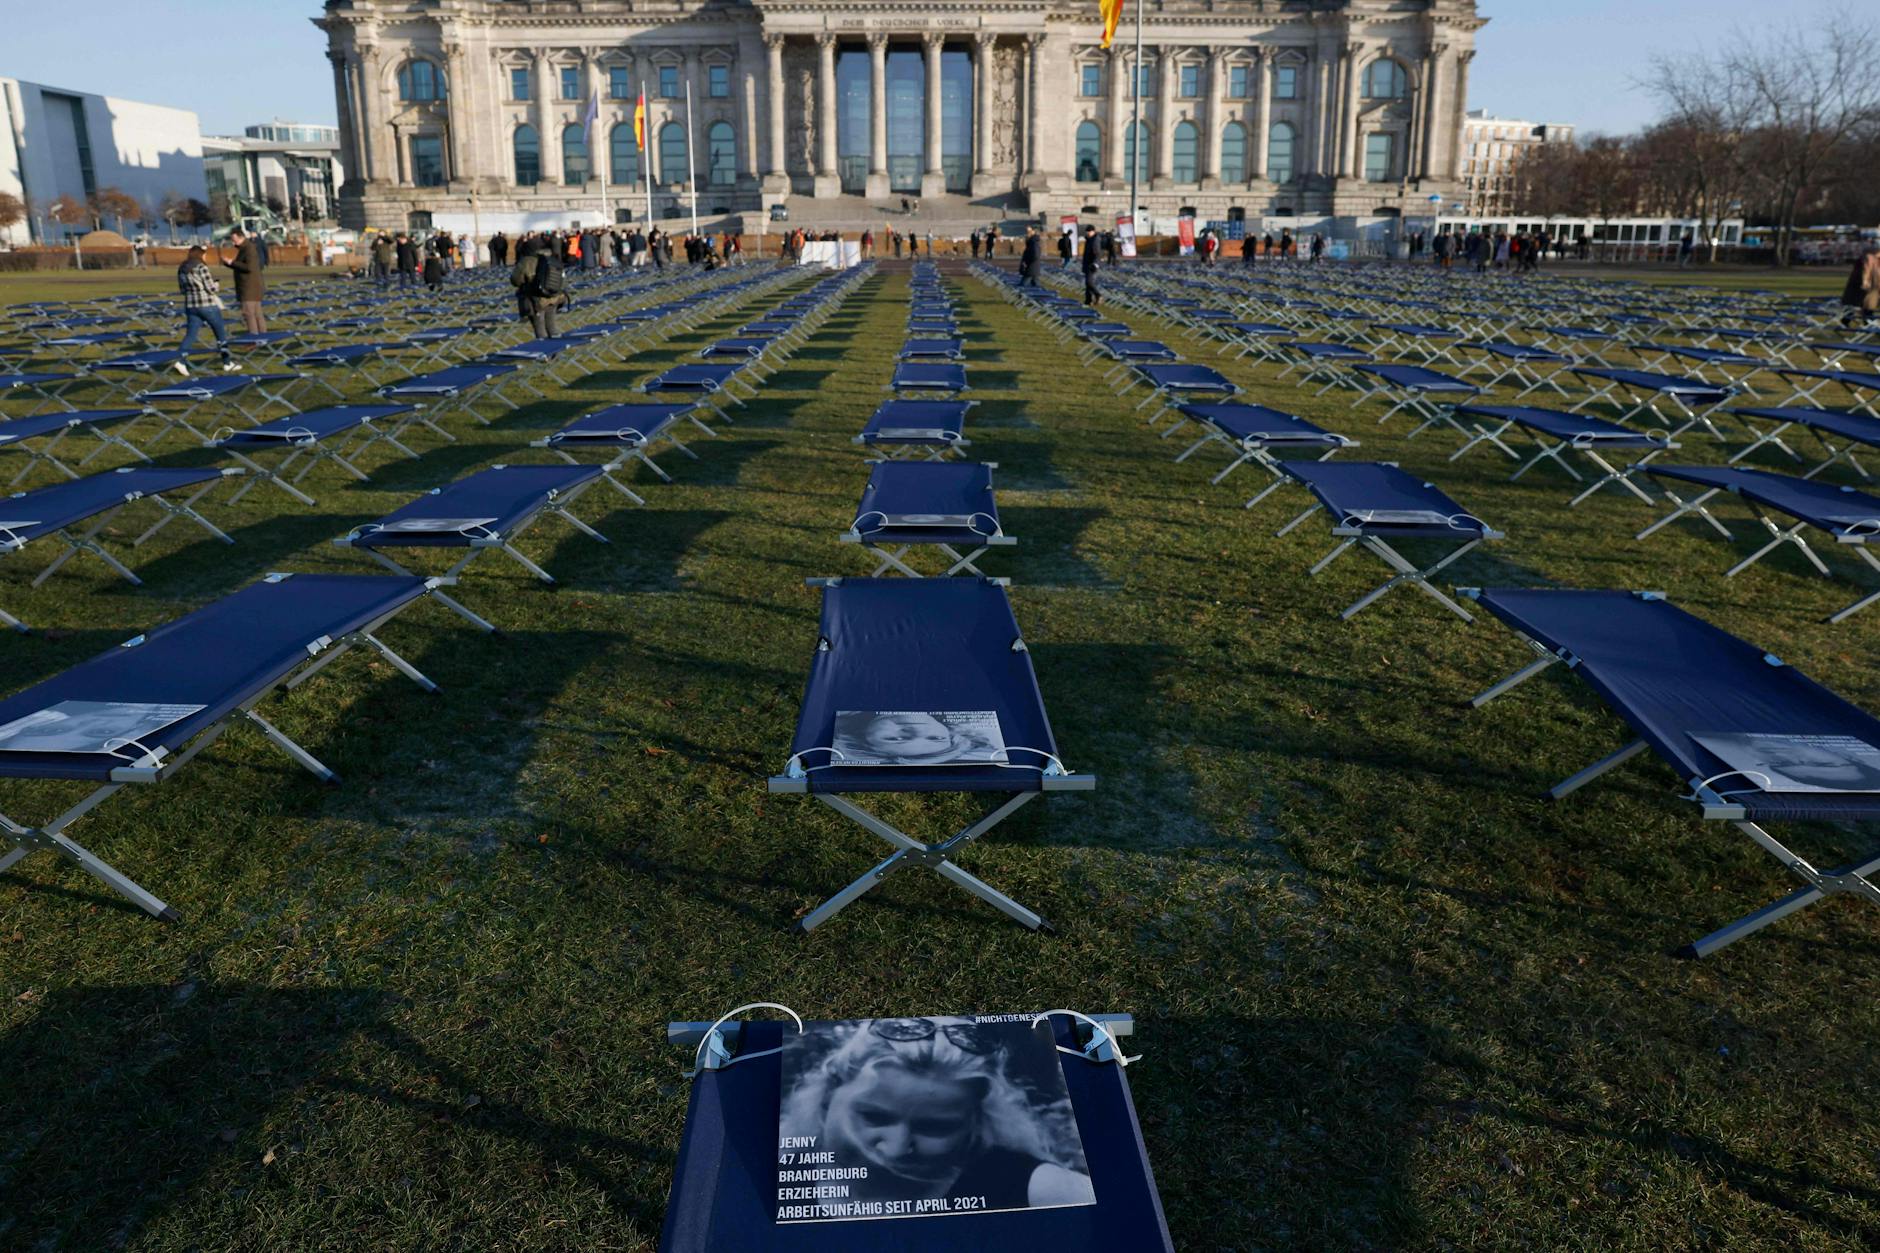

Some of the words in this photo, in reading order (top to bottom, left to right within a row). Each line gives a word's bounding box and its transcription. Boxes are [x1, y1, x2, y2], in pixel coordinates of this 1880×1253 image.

[779, 1136, 817, 1149] JENNY
[779, 1153, 795, 1165] 47
[798, 1151, 835, 1164] JAHRE
[779, 1167, 868, 1182] BRANDENBURG
[778, 1185, 849, 1200] ERZIEHERIN
[777, 1201, 883, 1219] ARBEITSUNFÄHIG
[885, 1200, 912, 1214] SEIT
[915, 1198, 951, 1212] APRIL
[954, 1196, 986, 1210] 2021
